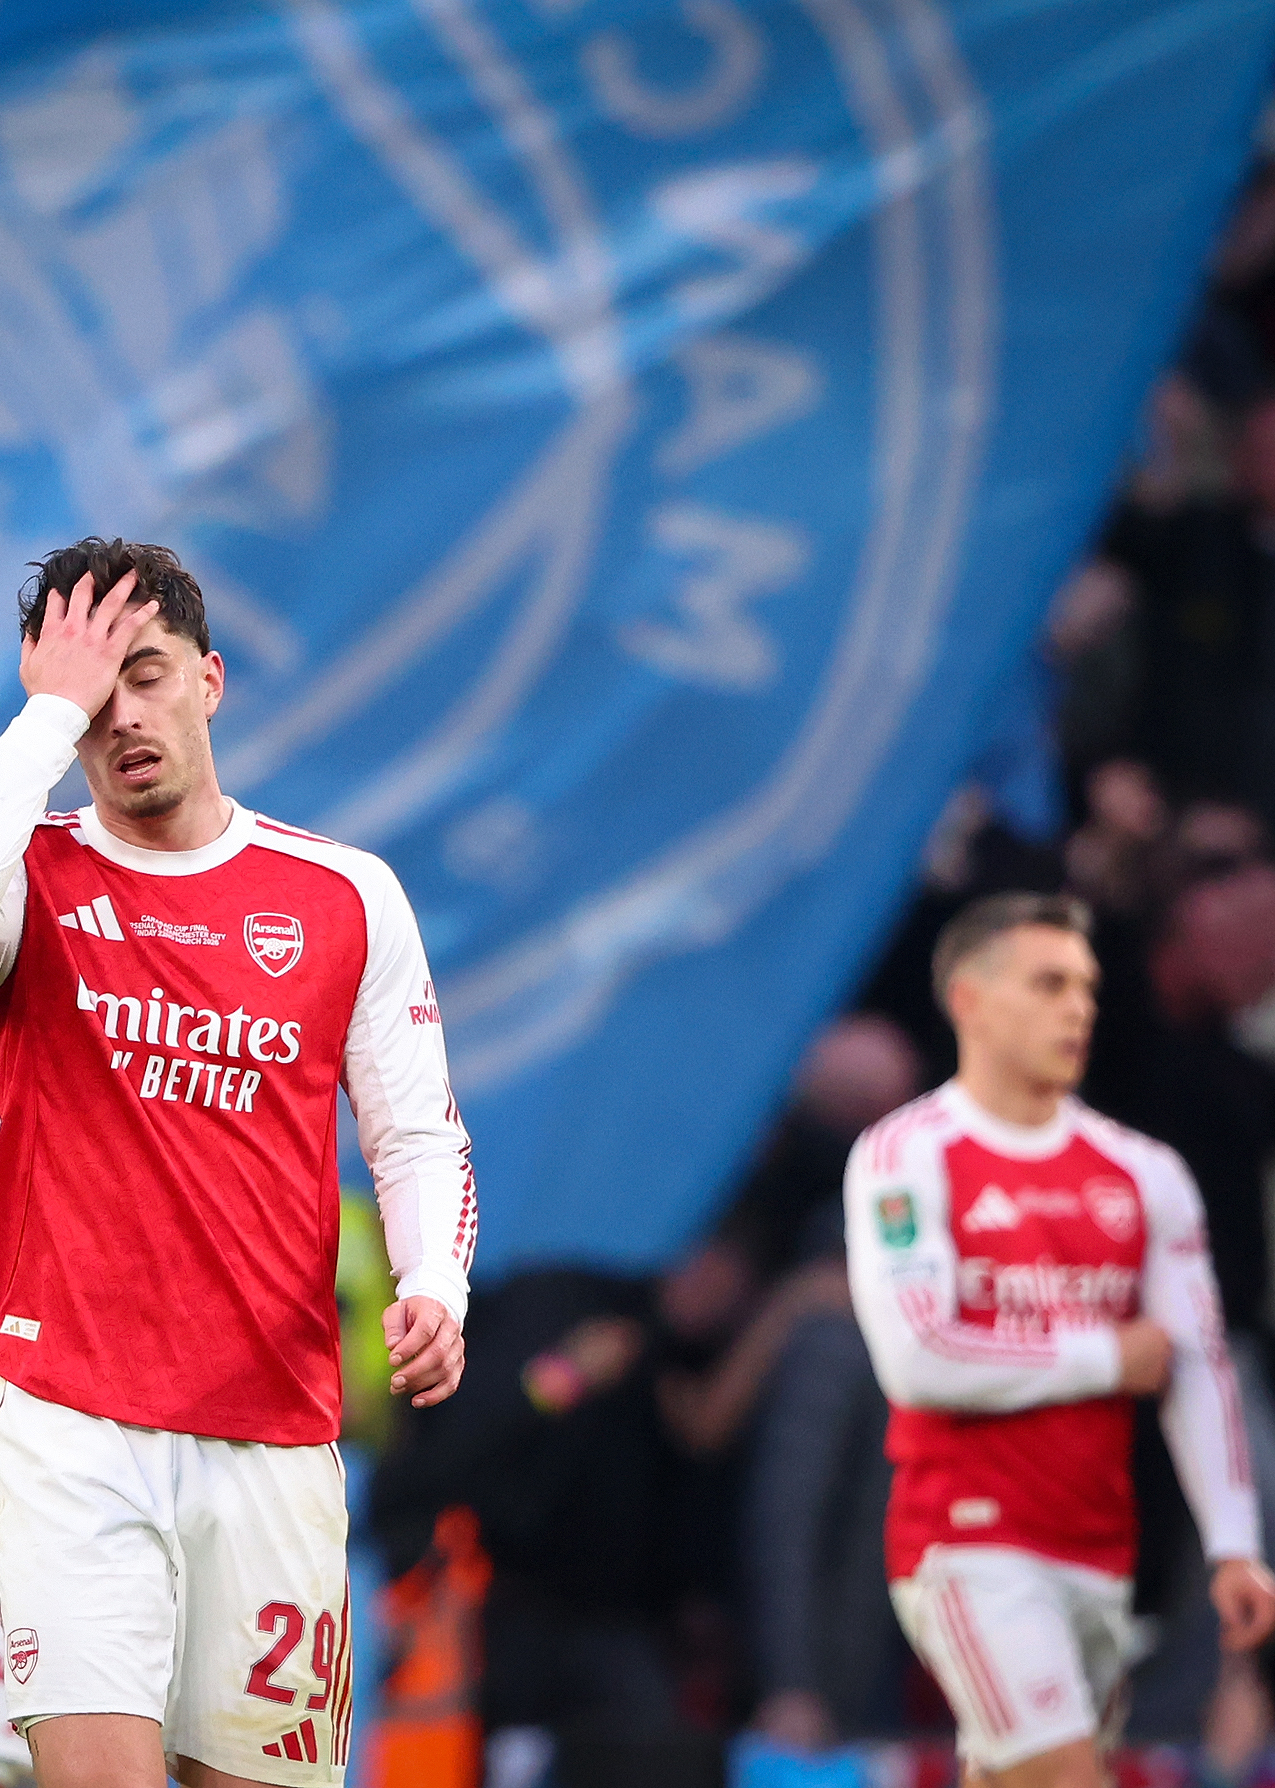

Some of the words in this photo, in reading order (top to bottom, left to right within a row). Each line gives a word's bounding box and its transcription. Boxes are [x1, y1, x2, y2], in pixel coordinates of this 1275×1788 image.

[129, 922, 156, 930] RSENAL
[210, 932, 226, 941] CITY
[189, 924, 210, 932] FINAL
[253, 922, 295, 936] Arsenal
[134, 929, 158, 937] UNDAY
[175, 936, 201, 945] MARCH
[202, 938, 220, 946] 2026
[408, 1004, 440, 1025] RWA
[139, 1055, 262, 1113] BETTER
[9, 1636, 33, 1649] Arsenal
[243, 1599, 337, 1713] 29
